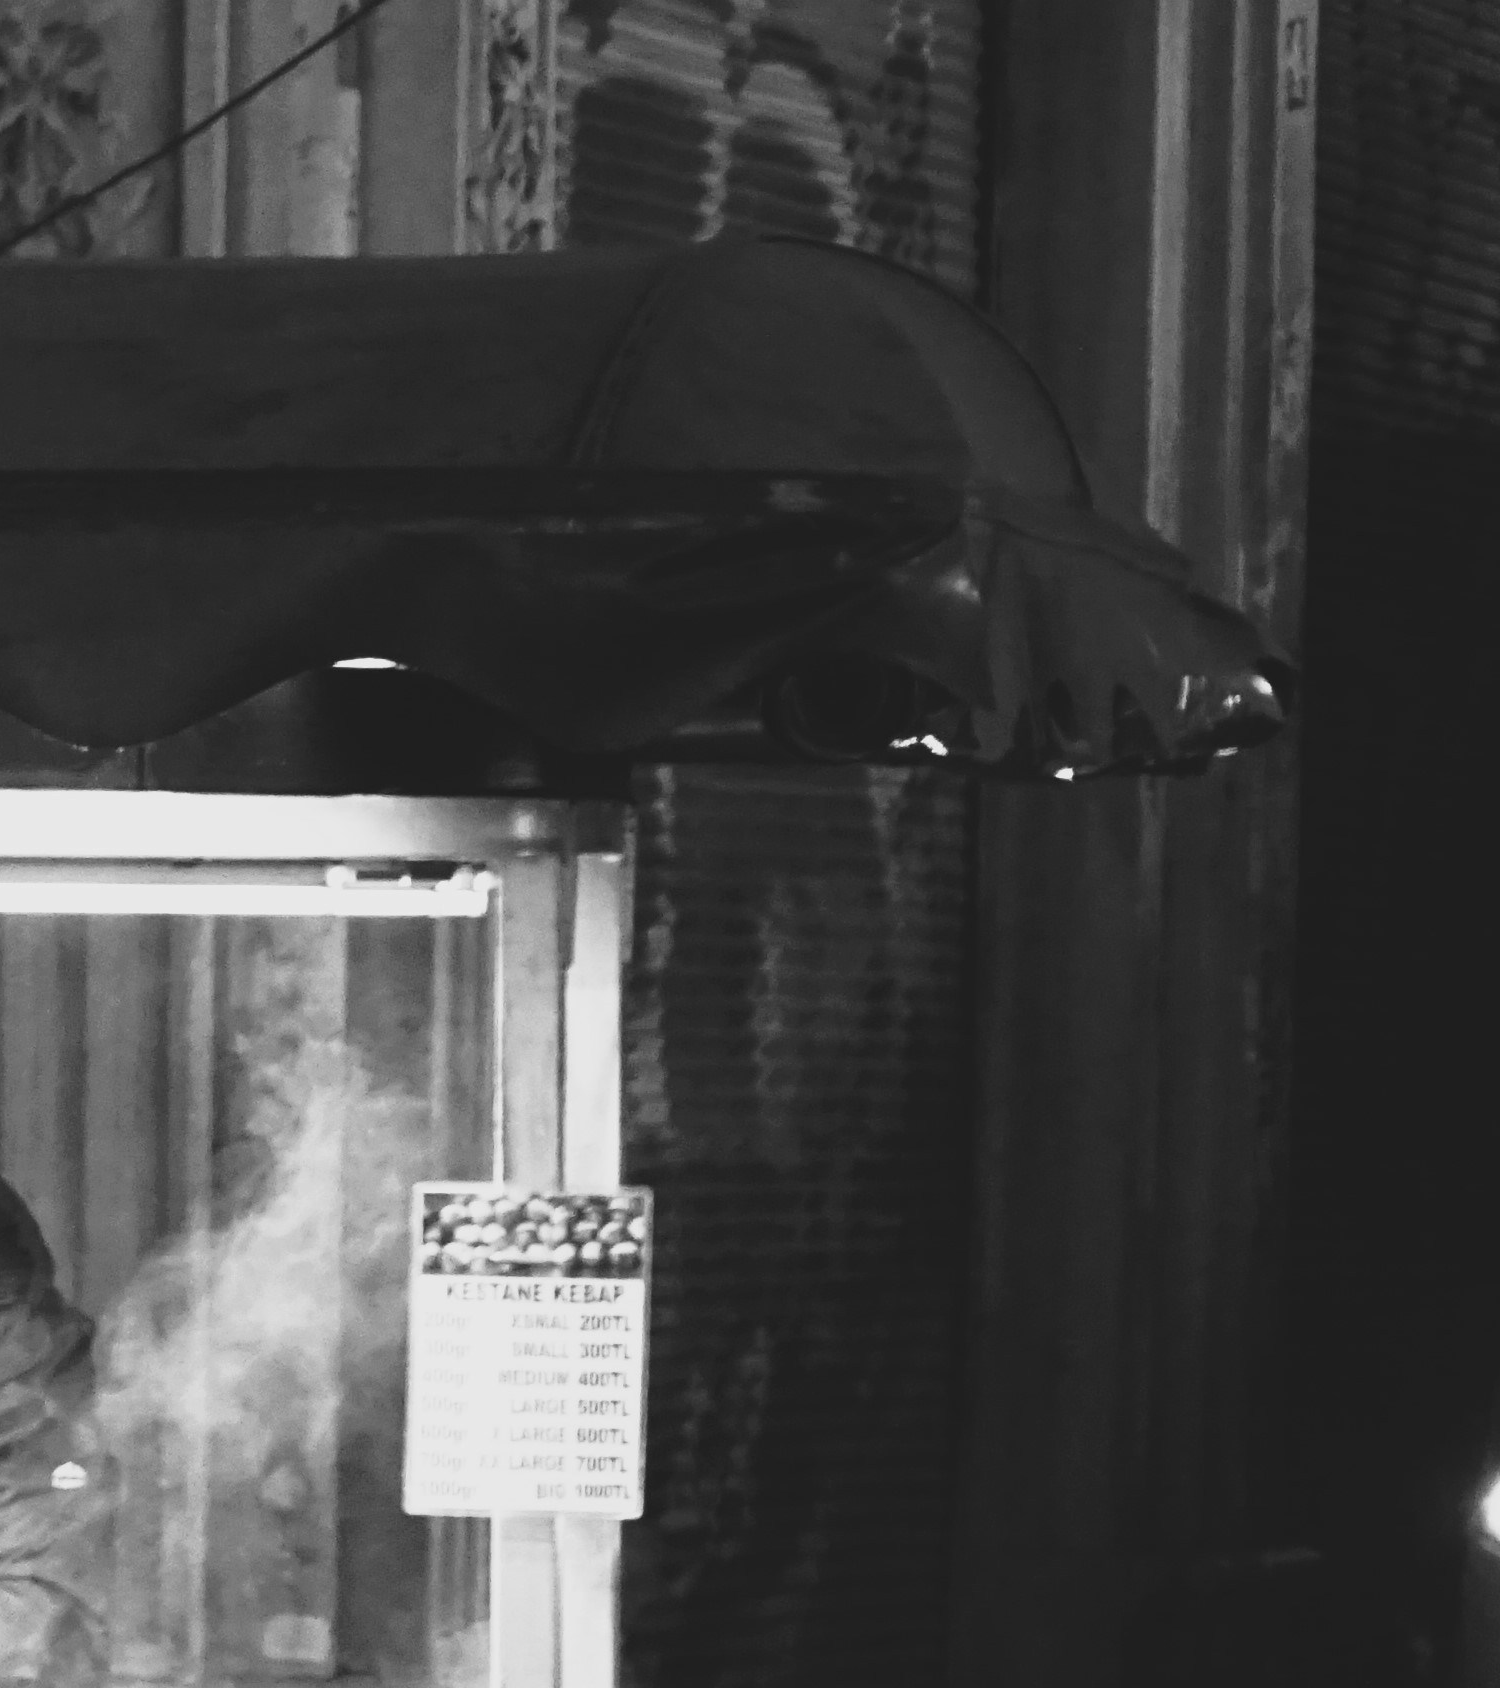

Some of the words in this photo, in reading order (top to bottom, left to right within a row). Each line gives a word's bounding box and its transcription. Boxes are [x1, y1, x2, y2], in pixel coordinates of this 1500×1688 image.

[445, 1281, 543, 1303] KESTANE
[553, 1283, 626, 1305] KEBAP
[579, 1314, 632, 1332] 200TL
[579, 1342, 632, 1361] 300TL
[497, 1370, 570, 1387] MEDIUM
[577, 1371, 631, 1389] 400TL
[510, 1398, 567, 1416] LARGE
[577, 1398, 631, 1417] 500TL
[509, 1427, 566, 1444] LARGE
[576, 1428, 630, 1445] 600TL
[508, 1455, 566, 1473] LARGE
[575, 1456, 628, 1474] 700TL
[574, 1483, 631, 1501] 1000TL
